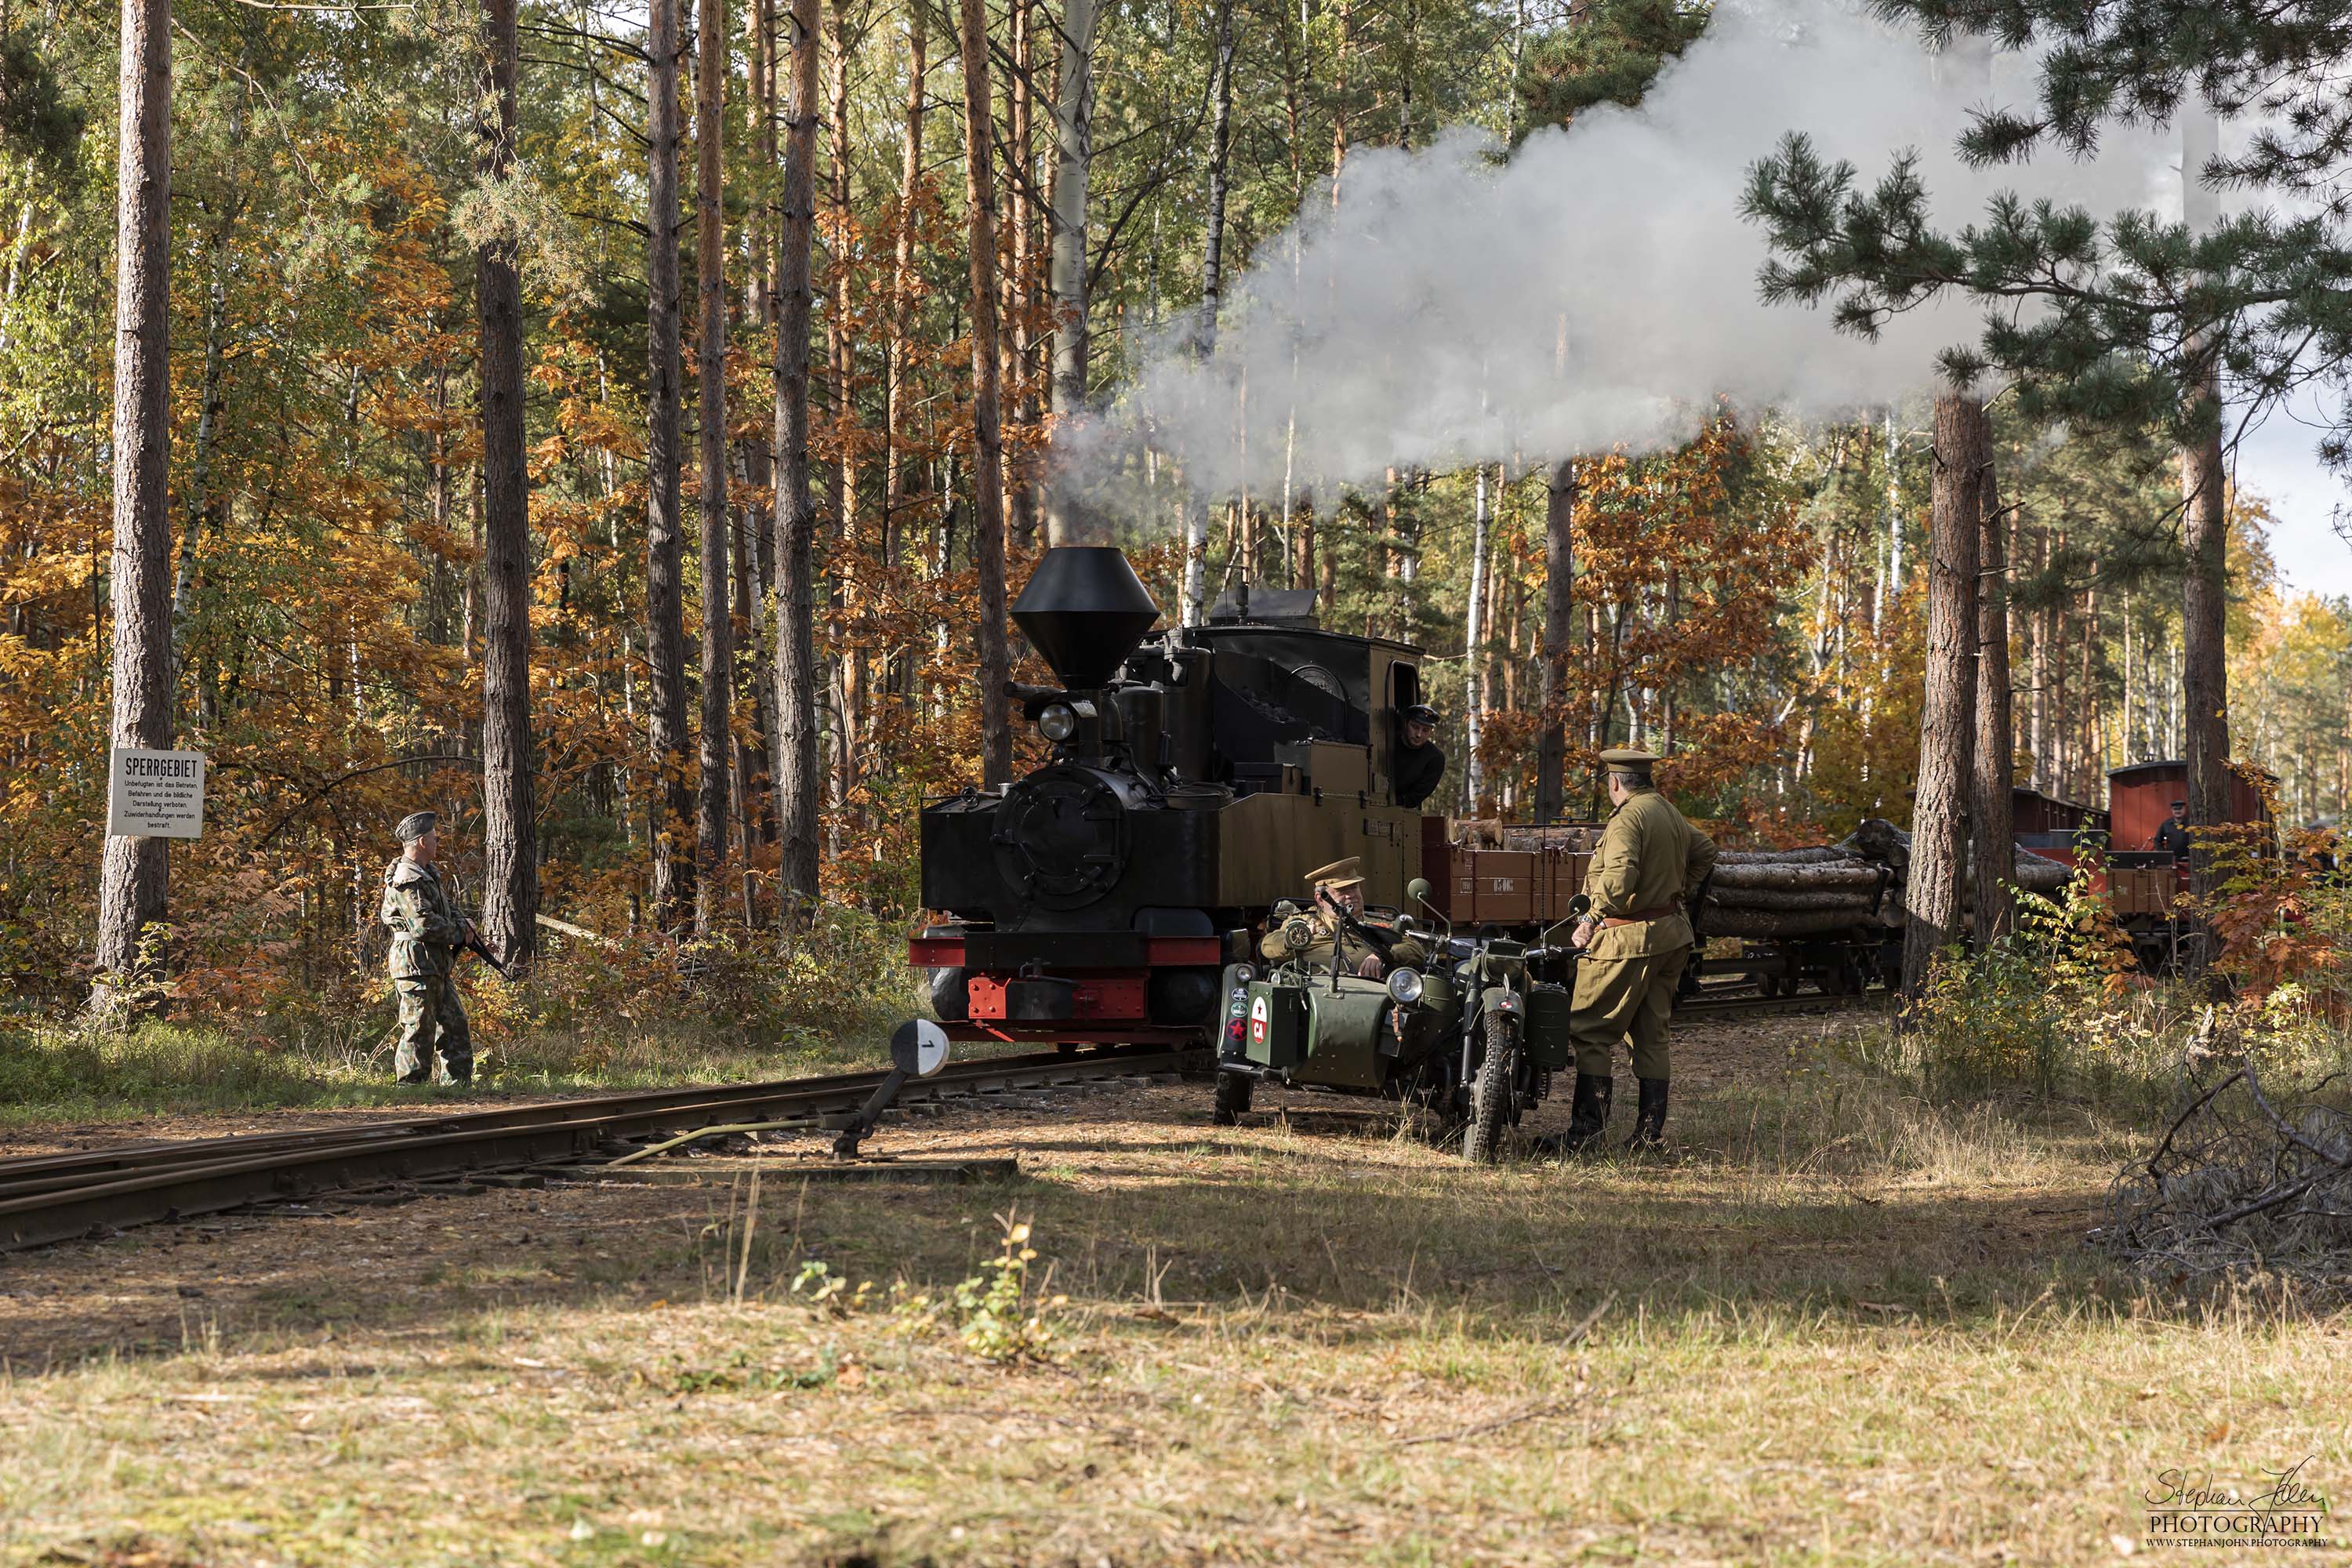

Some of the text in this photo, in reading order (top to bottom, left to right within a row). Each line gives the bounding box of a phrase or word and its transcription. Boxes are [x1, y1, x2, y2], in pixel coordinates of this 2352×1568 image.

[125, 757, 197, 778] SPERRGEBIET
[124, 780, 154, 789] Unbefugten
[124, 810, 174, 820] Zuwiderhandlungen
